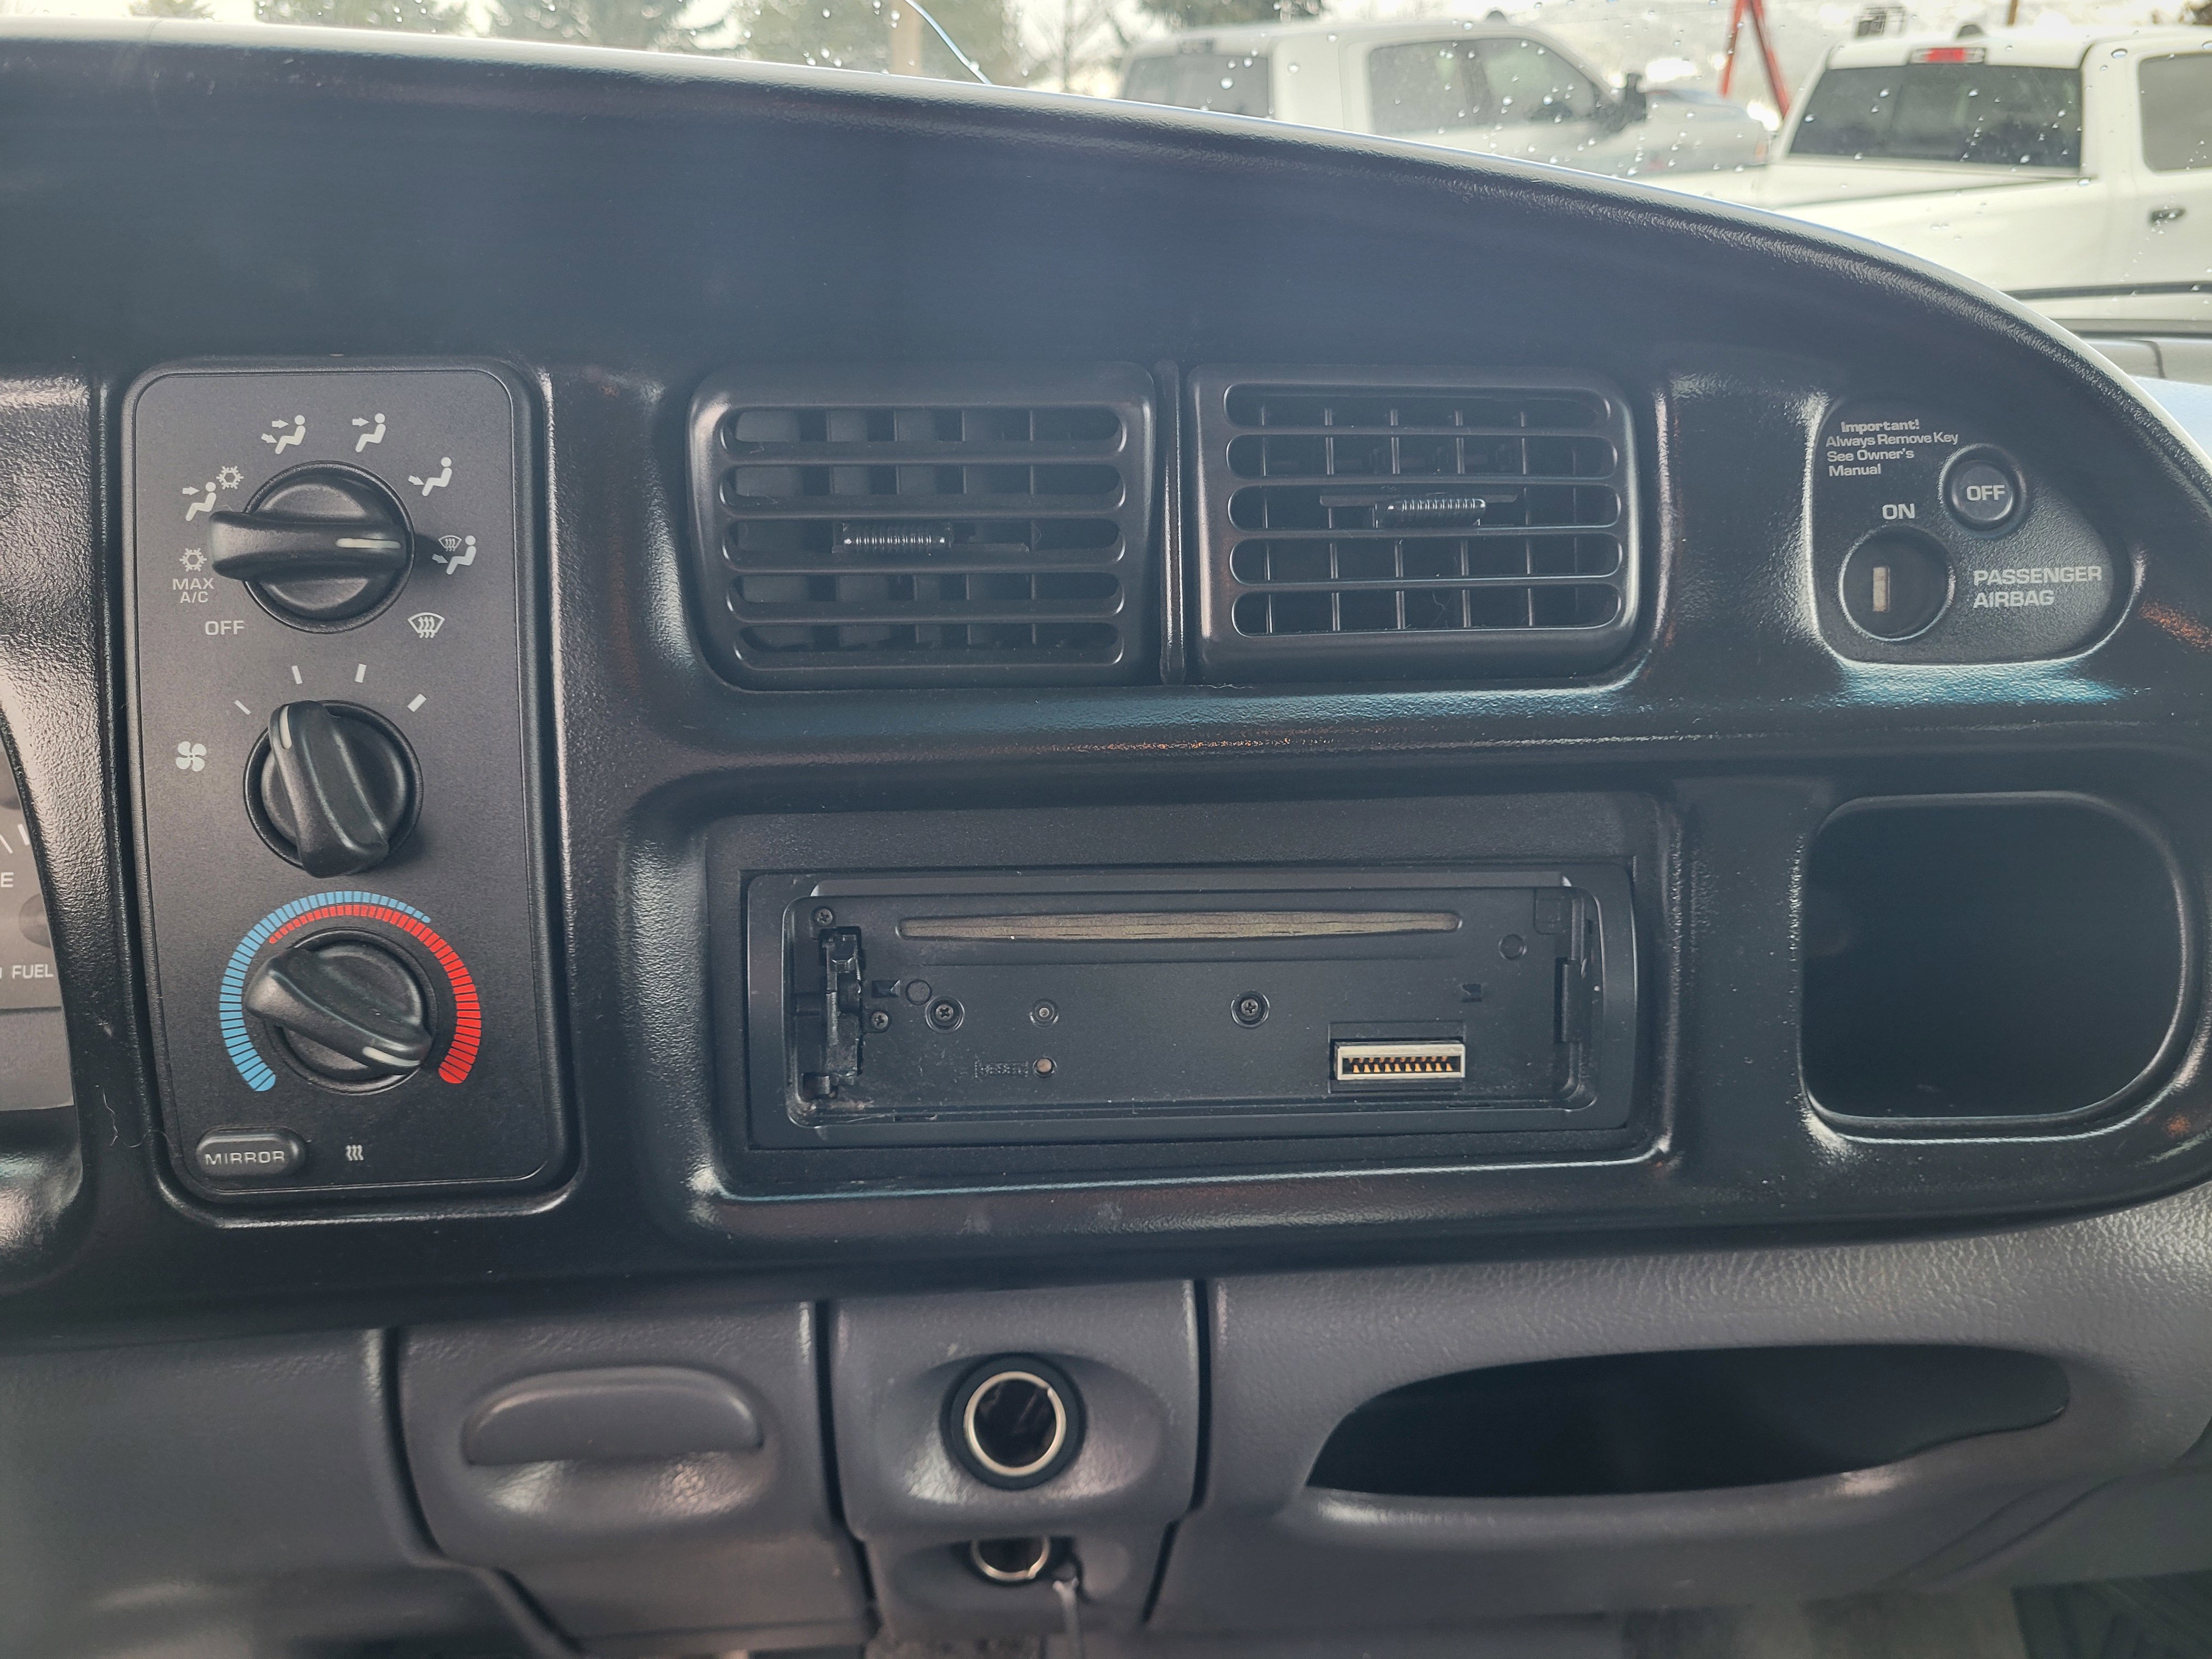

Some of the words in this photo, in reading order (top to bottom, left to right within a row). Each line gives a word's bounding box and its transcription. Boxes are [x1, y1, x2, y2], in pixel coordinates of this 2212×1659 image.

[1841, 419, 1920, 435] Important!
[1826, 435, 1875, 449] Always
[1877, 434, 1932, 445] Remove
[1933, 431, 1958, 445] Key
[1827, 451, 1854, 462] See
[1857, 448, 1914, 461] Owner's
[1829, 464, 1881, 477] Manual
[1966, 485, 2005, 501] OFF
[1882, 504, 1915, 520] ON
[1974, 566, 2102, 585] PASSENGER
[172, 578, 214, 590] MAX
[180, 591, 208, 603] A/C
[1973, 590, 2054, 608] AIRBAG
[205, 620, 245, 635] OFF
[1, 872, 14, 888] E
[12, 963, 54, 979] FUEL
[205, 1150, 285, 1165] MIRROR
